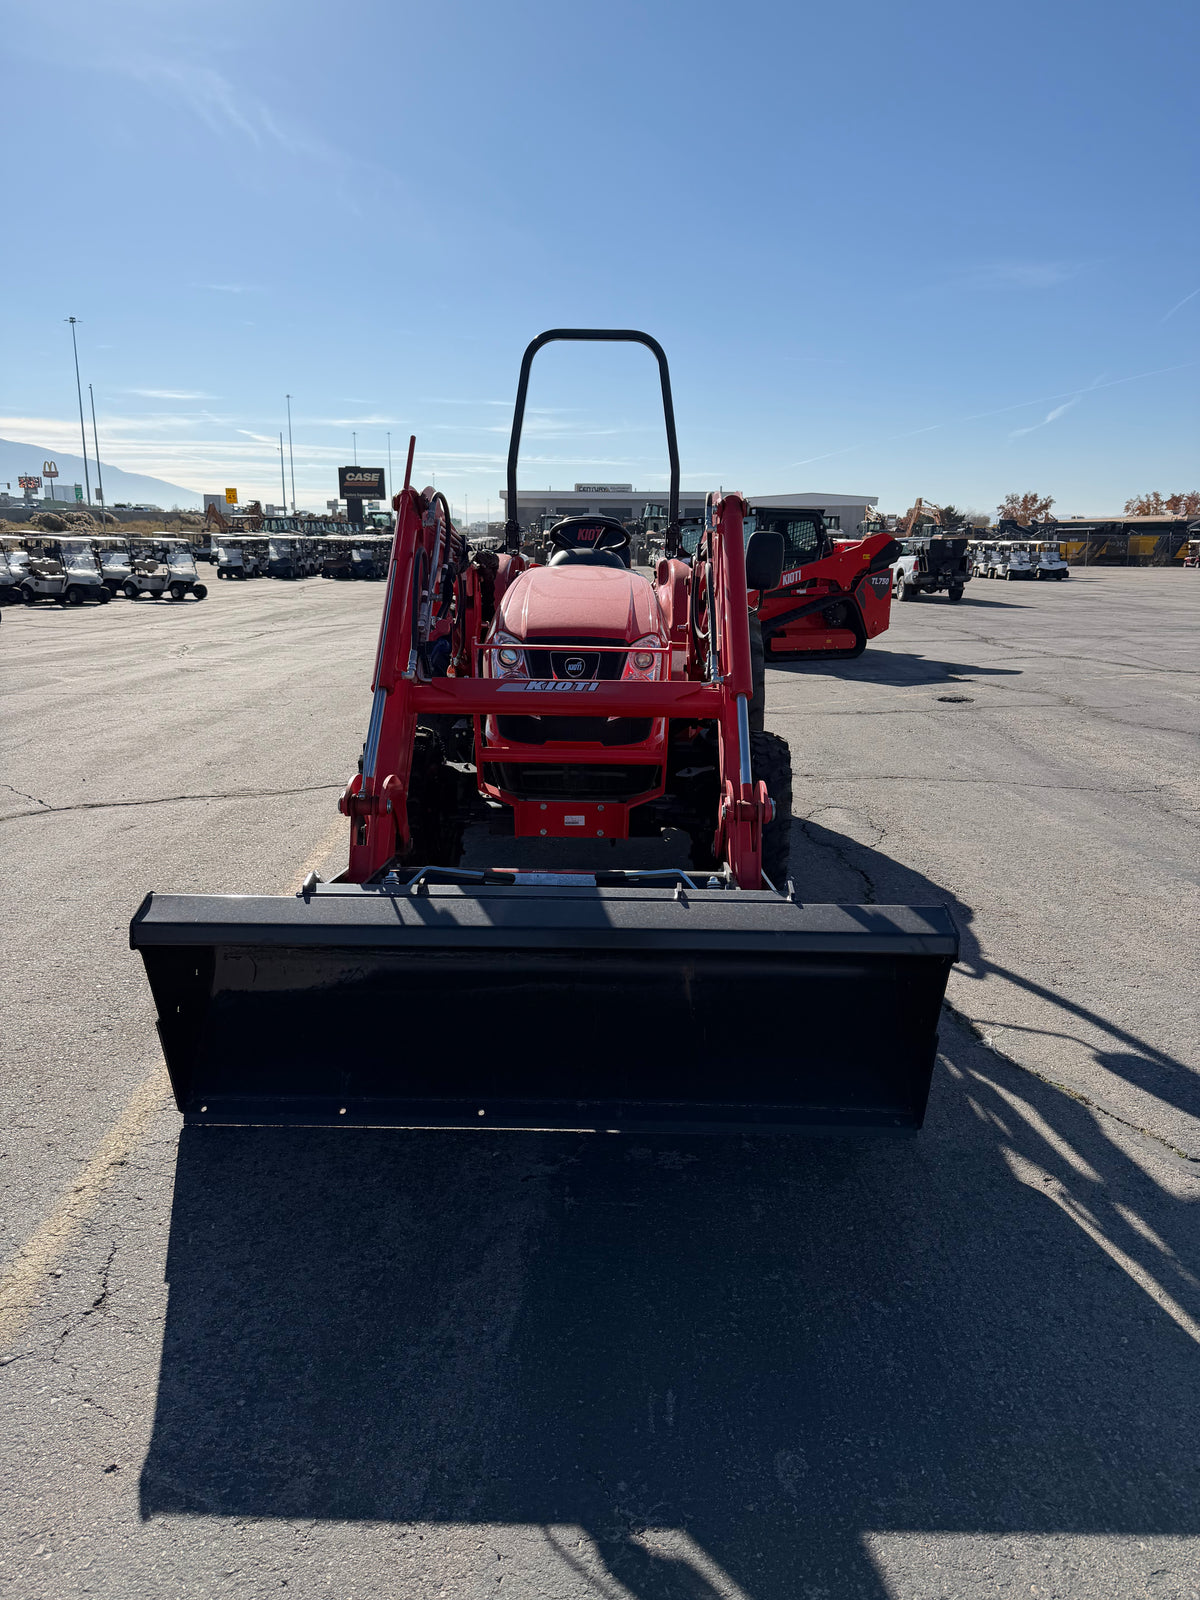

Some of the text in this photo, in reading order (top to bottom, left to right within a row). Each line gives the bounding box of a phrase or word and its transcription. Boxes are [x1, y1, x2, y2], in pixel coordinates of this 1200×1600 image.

[345, 472, 380, 482] CASE
[577, 528, 602, 541] KIOT
[782, 569, 801, 586] KIOTI
[871, 577, 890, 585] TL750
[567, 661, 582, 671] KIOTI
[525, 681, 600, 691] KIOTI
